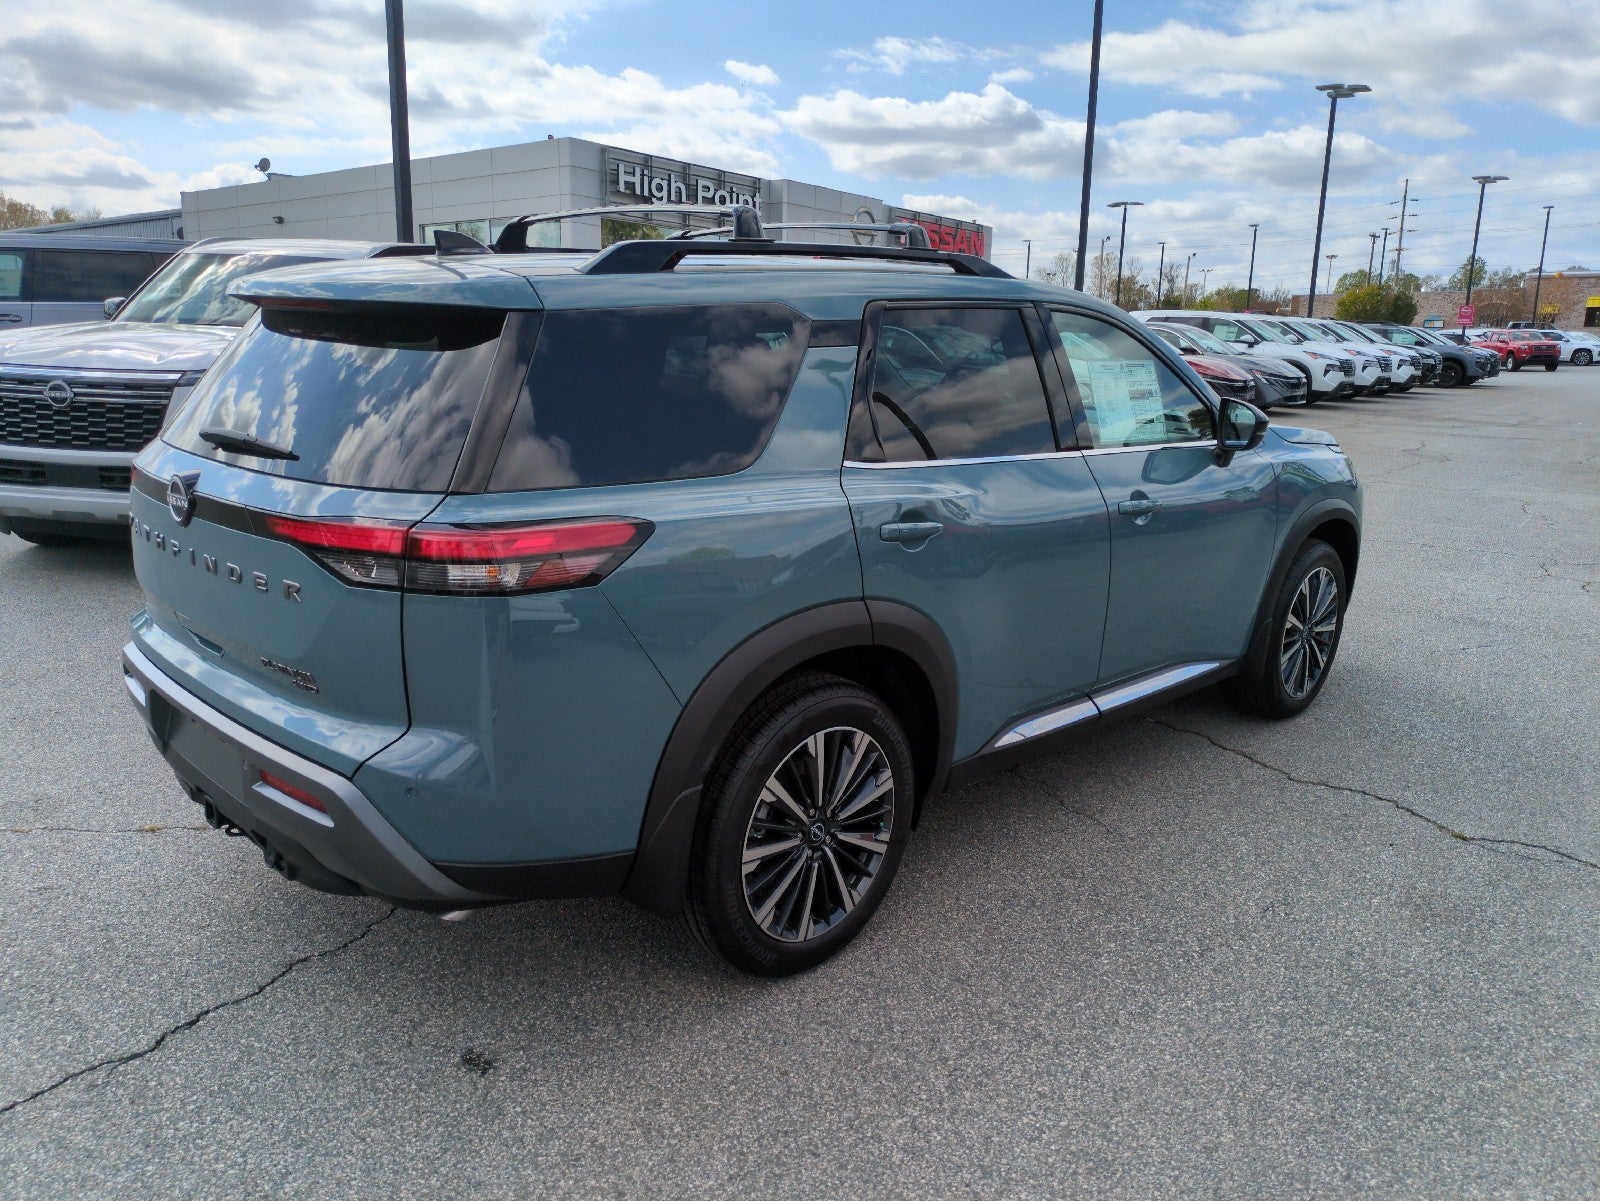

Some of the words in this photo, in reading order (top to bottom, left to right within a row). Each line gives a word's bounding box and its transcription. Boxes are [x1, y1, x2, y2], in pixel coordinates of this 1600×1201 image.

[616, 162, 687, 206] High
[695, 178, 761, 214] Point
[902, 217, 985, 256] SSAN
